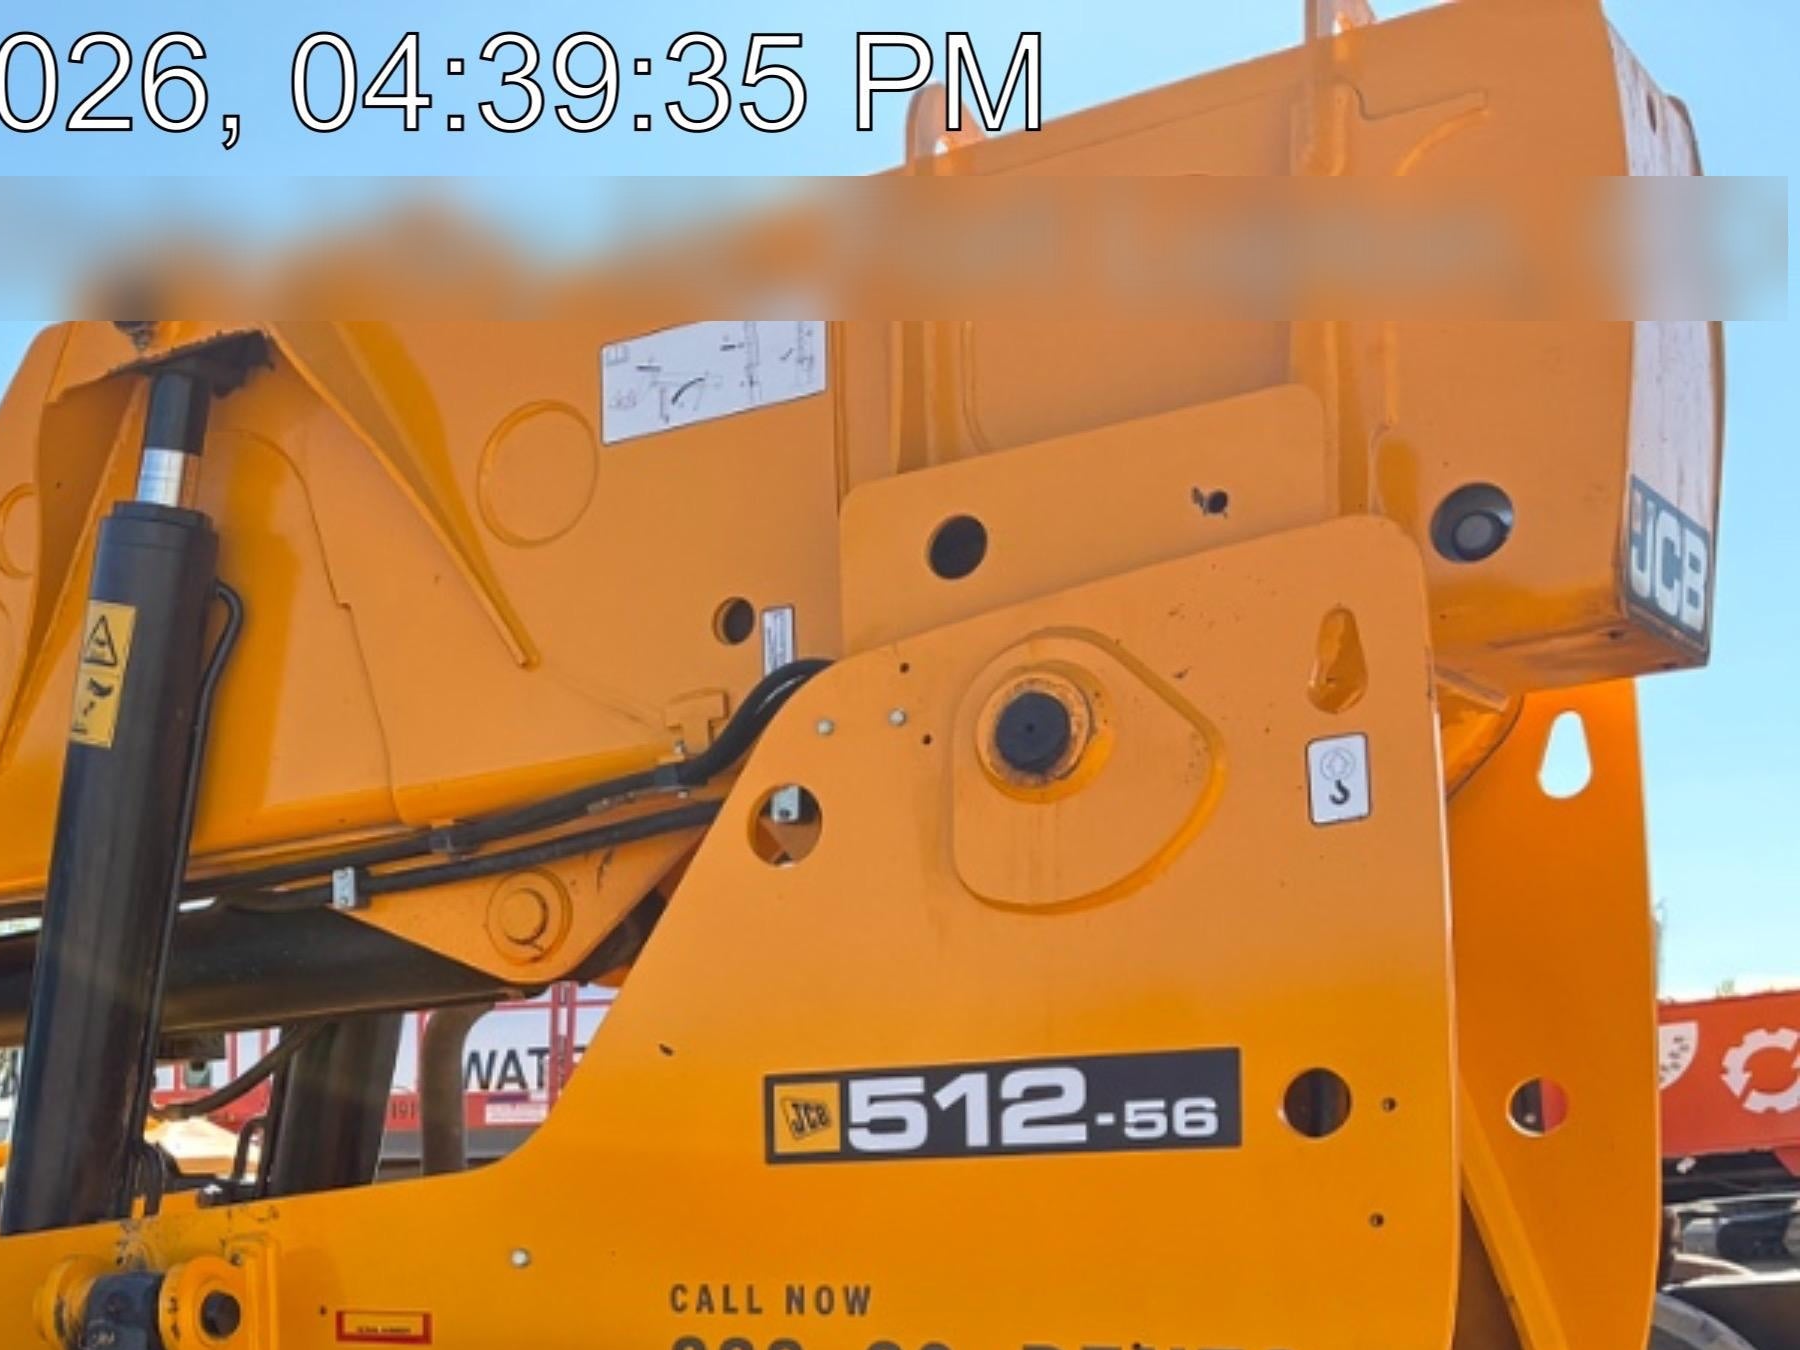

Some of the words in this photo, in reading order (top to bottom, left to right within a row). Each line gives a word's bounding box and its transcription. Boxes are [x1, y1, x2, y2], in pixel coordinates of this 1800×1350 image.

[1631, 498, 1708, 632] JCB
[848, 1067, 1218, 1152] 512-56
[669, 1284, 763, 1316] CALL
[785, 1285, 872, 1316] NOW
